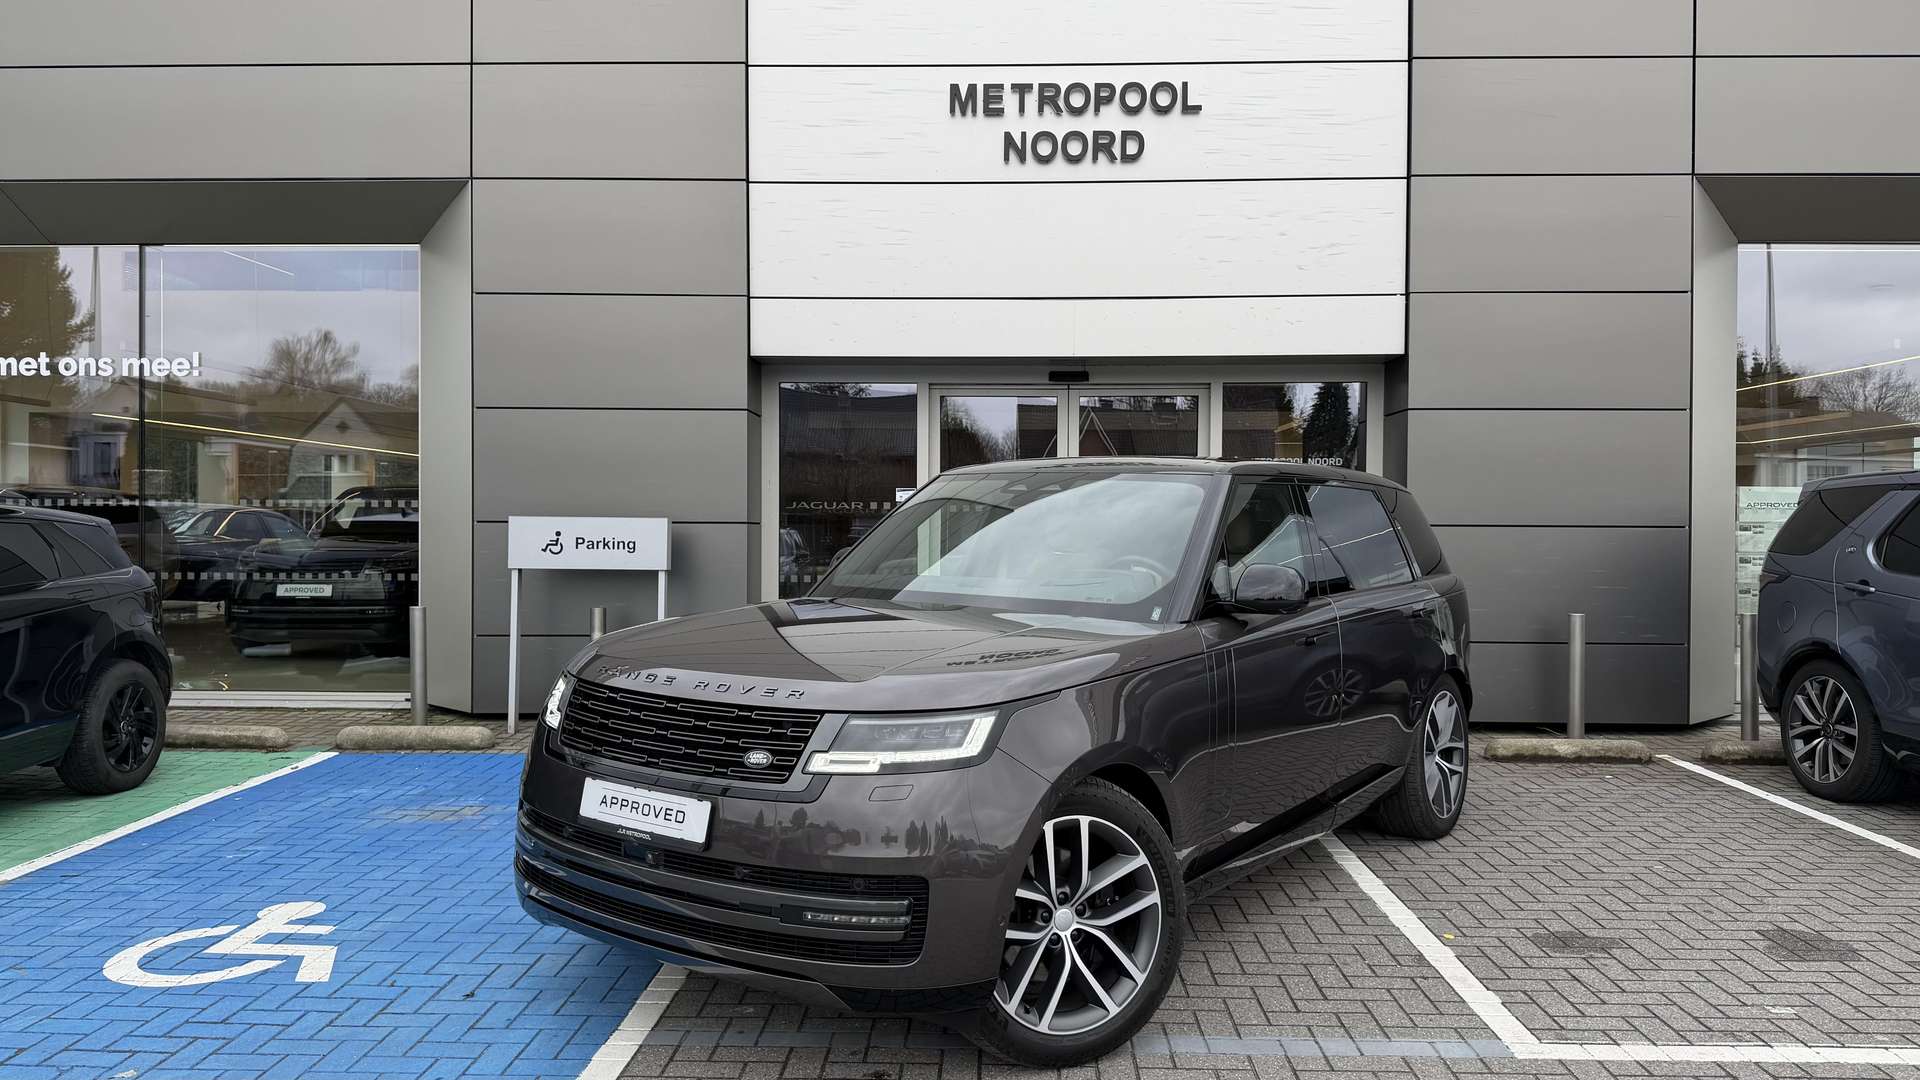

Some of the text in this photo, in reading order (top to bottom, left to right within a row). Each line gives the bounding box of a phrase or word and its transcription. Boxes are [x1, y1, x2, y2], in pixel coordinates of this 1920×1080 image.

[949, 81, 1203, 117] METROPOOL
[1003, 130, 1146, 165] NOORD
[58, 357, 114, 377] ons
[121, 351, 201, 377] mee!
[1307, 457, 1343, 466] NOORD
[784, 500, 865, 510] JAGUAR
[574, 536, 637, 554] Parking
[284, 586, 325, 594] APPROVED
[600, 665, 805, 700] RANGE ROVER
[599, 793, 687, 825] APPROVED
